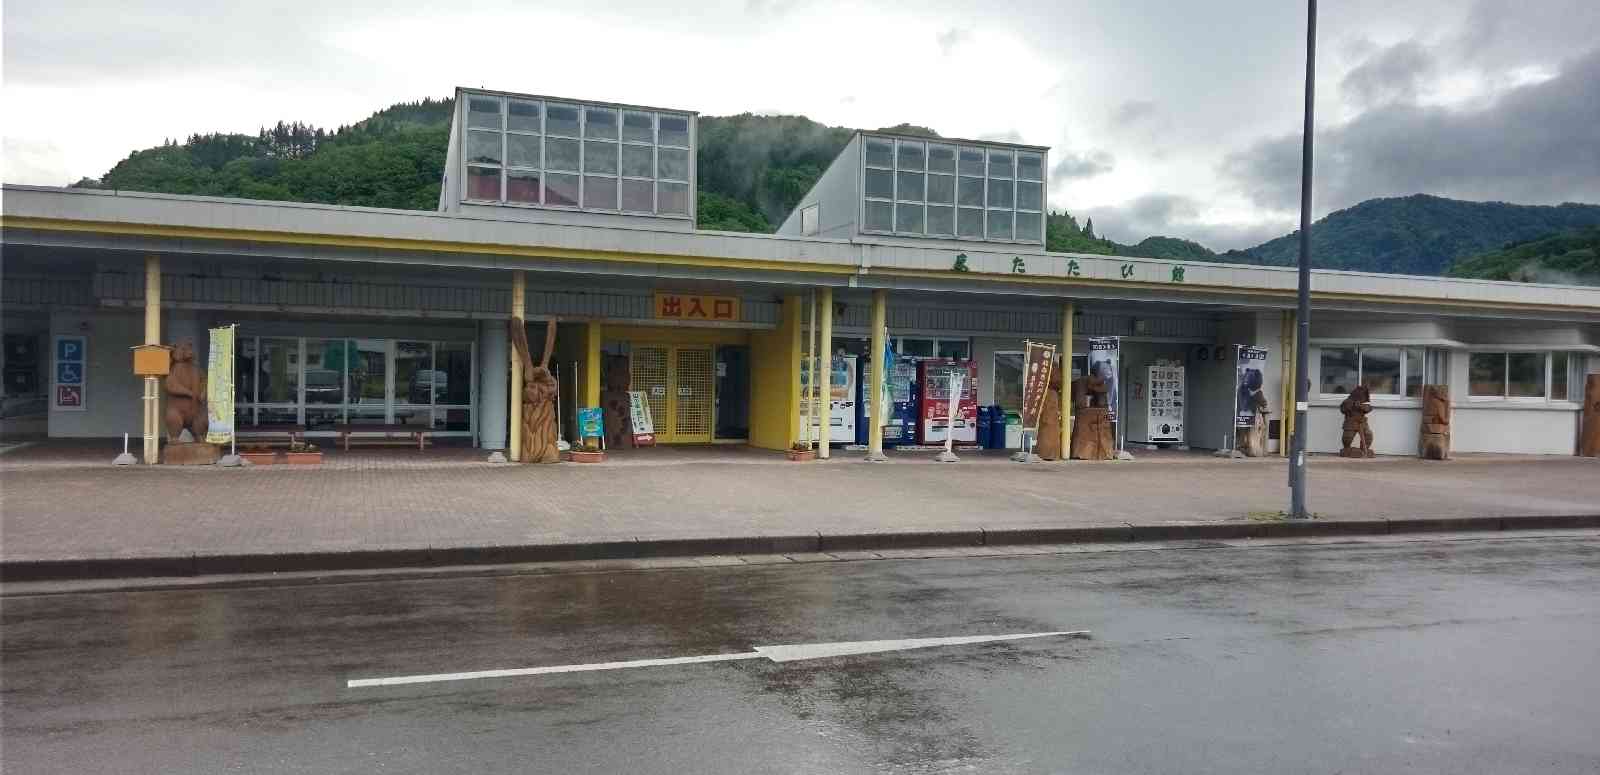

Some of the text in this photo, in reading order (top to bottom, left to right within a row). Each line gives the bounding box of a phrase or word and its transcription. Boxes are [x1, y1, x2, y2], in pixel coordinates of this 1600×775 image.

[662, 297, 733, 318] 出入口
[64, 343, 77, 358] P
